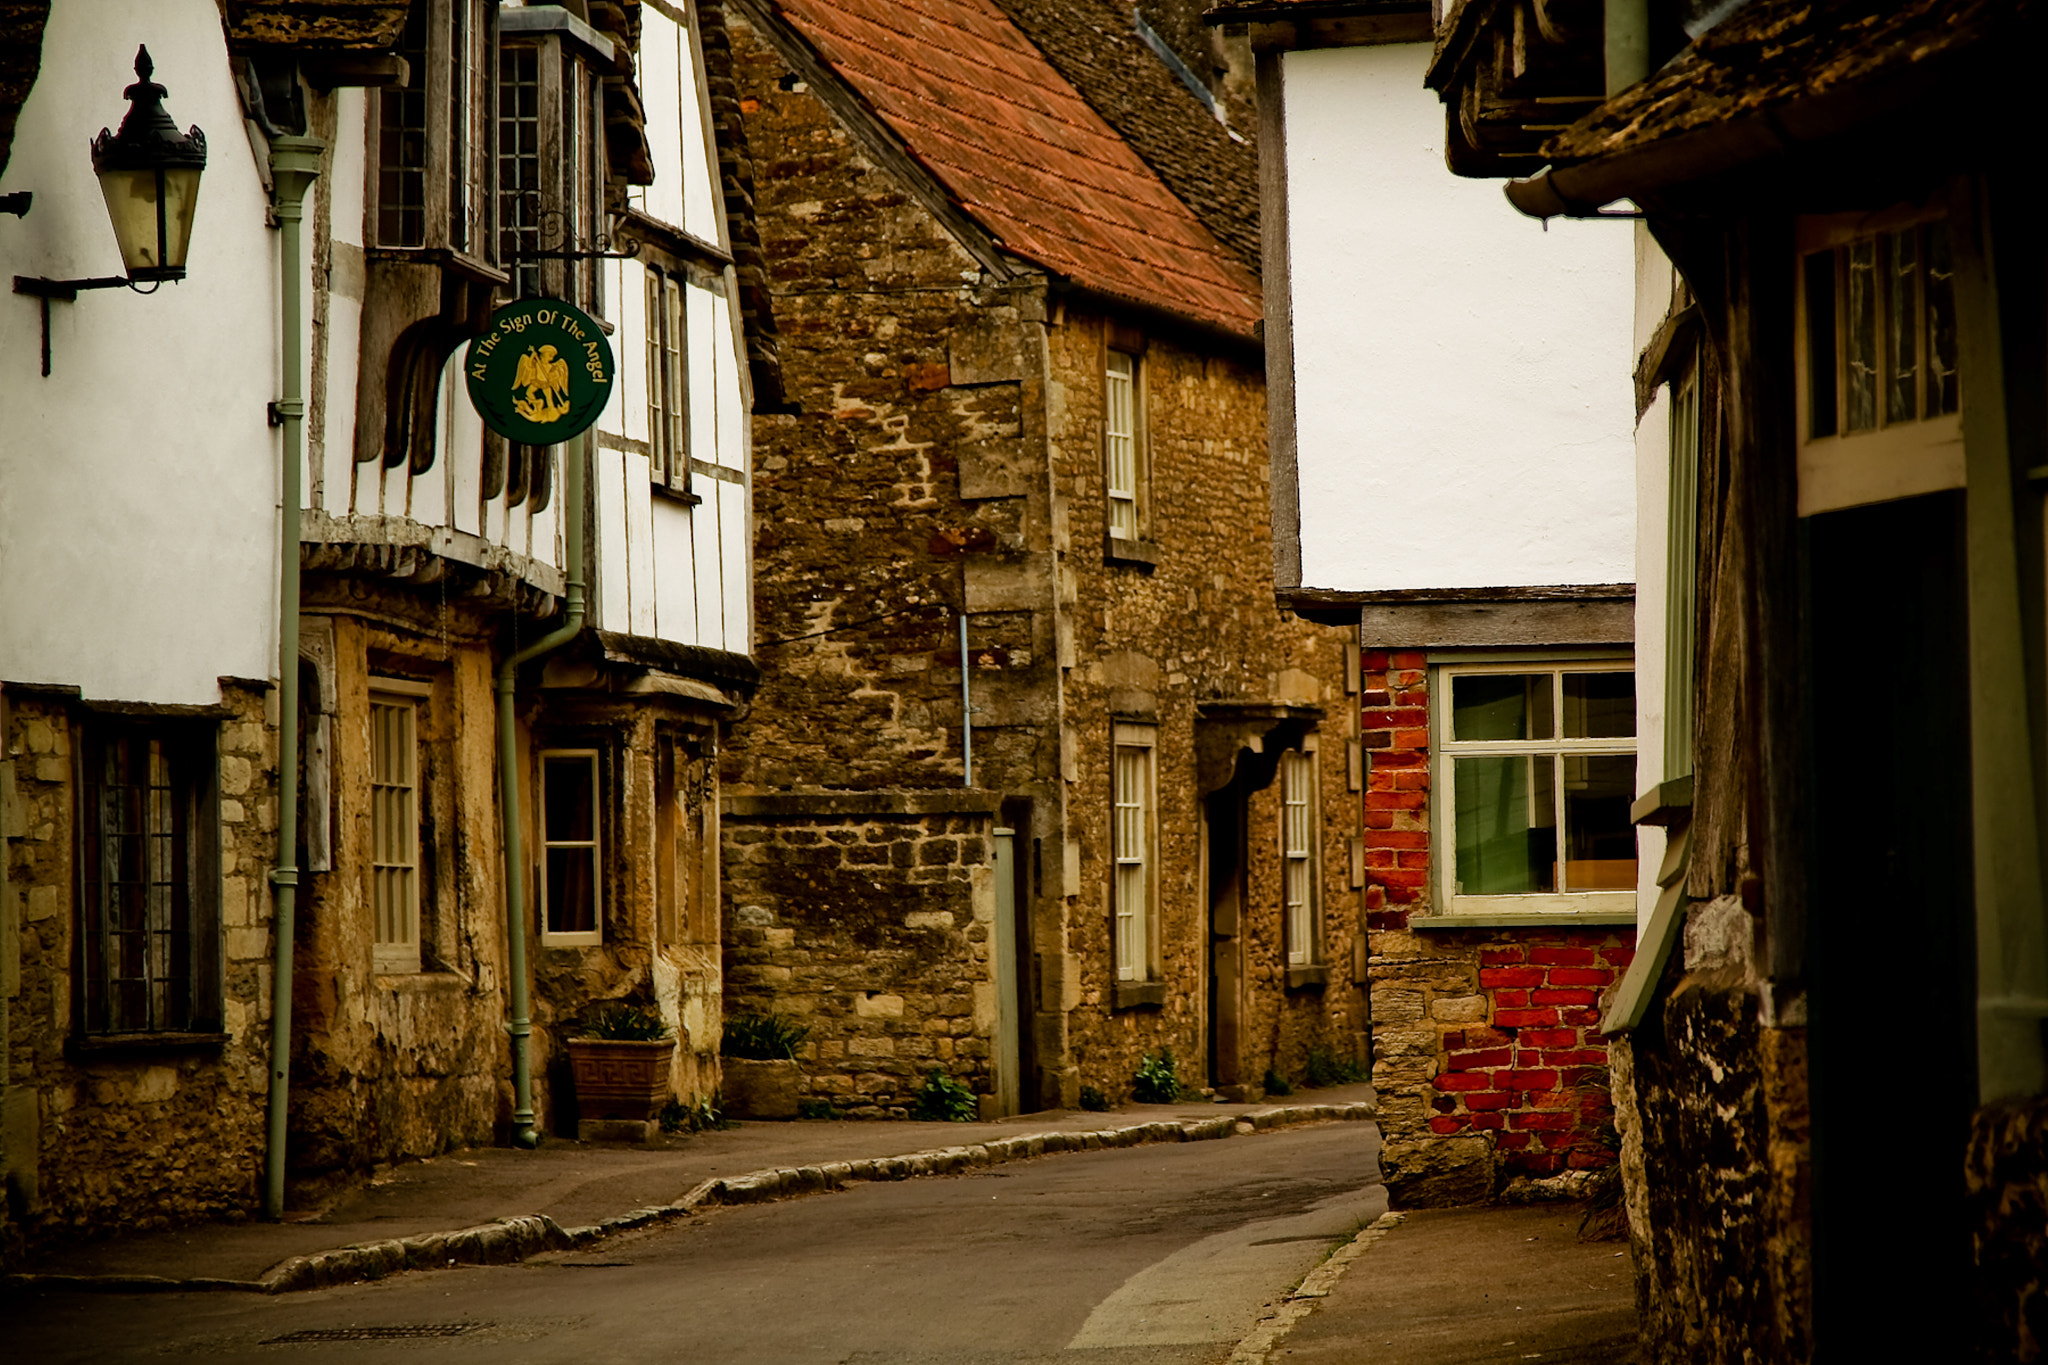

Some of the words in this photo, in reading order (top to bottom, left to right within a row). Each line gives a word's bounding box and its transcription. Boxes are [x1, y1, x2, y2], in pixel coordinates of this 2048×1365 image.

[499, 313, 533, 333] Sign
[537, 309, 559, 325] Of
[561, 314, 586, 341] The
[476, 332, 501, 357] The
[471, 363, 487, 381] At
[582, 341, 608, 383] Angel
